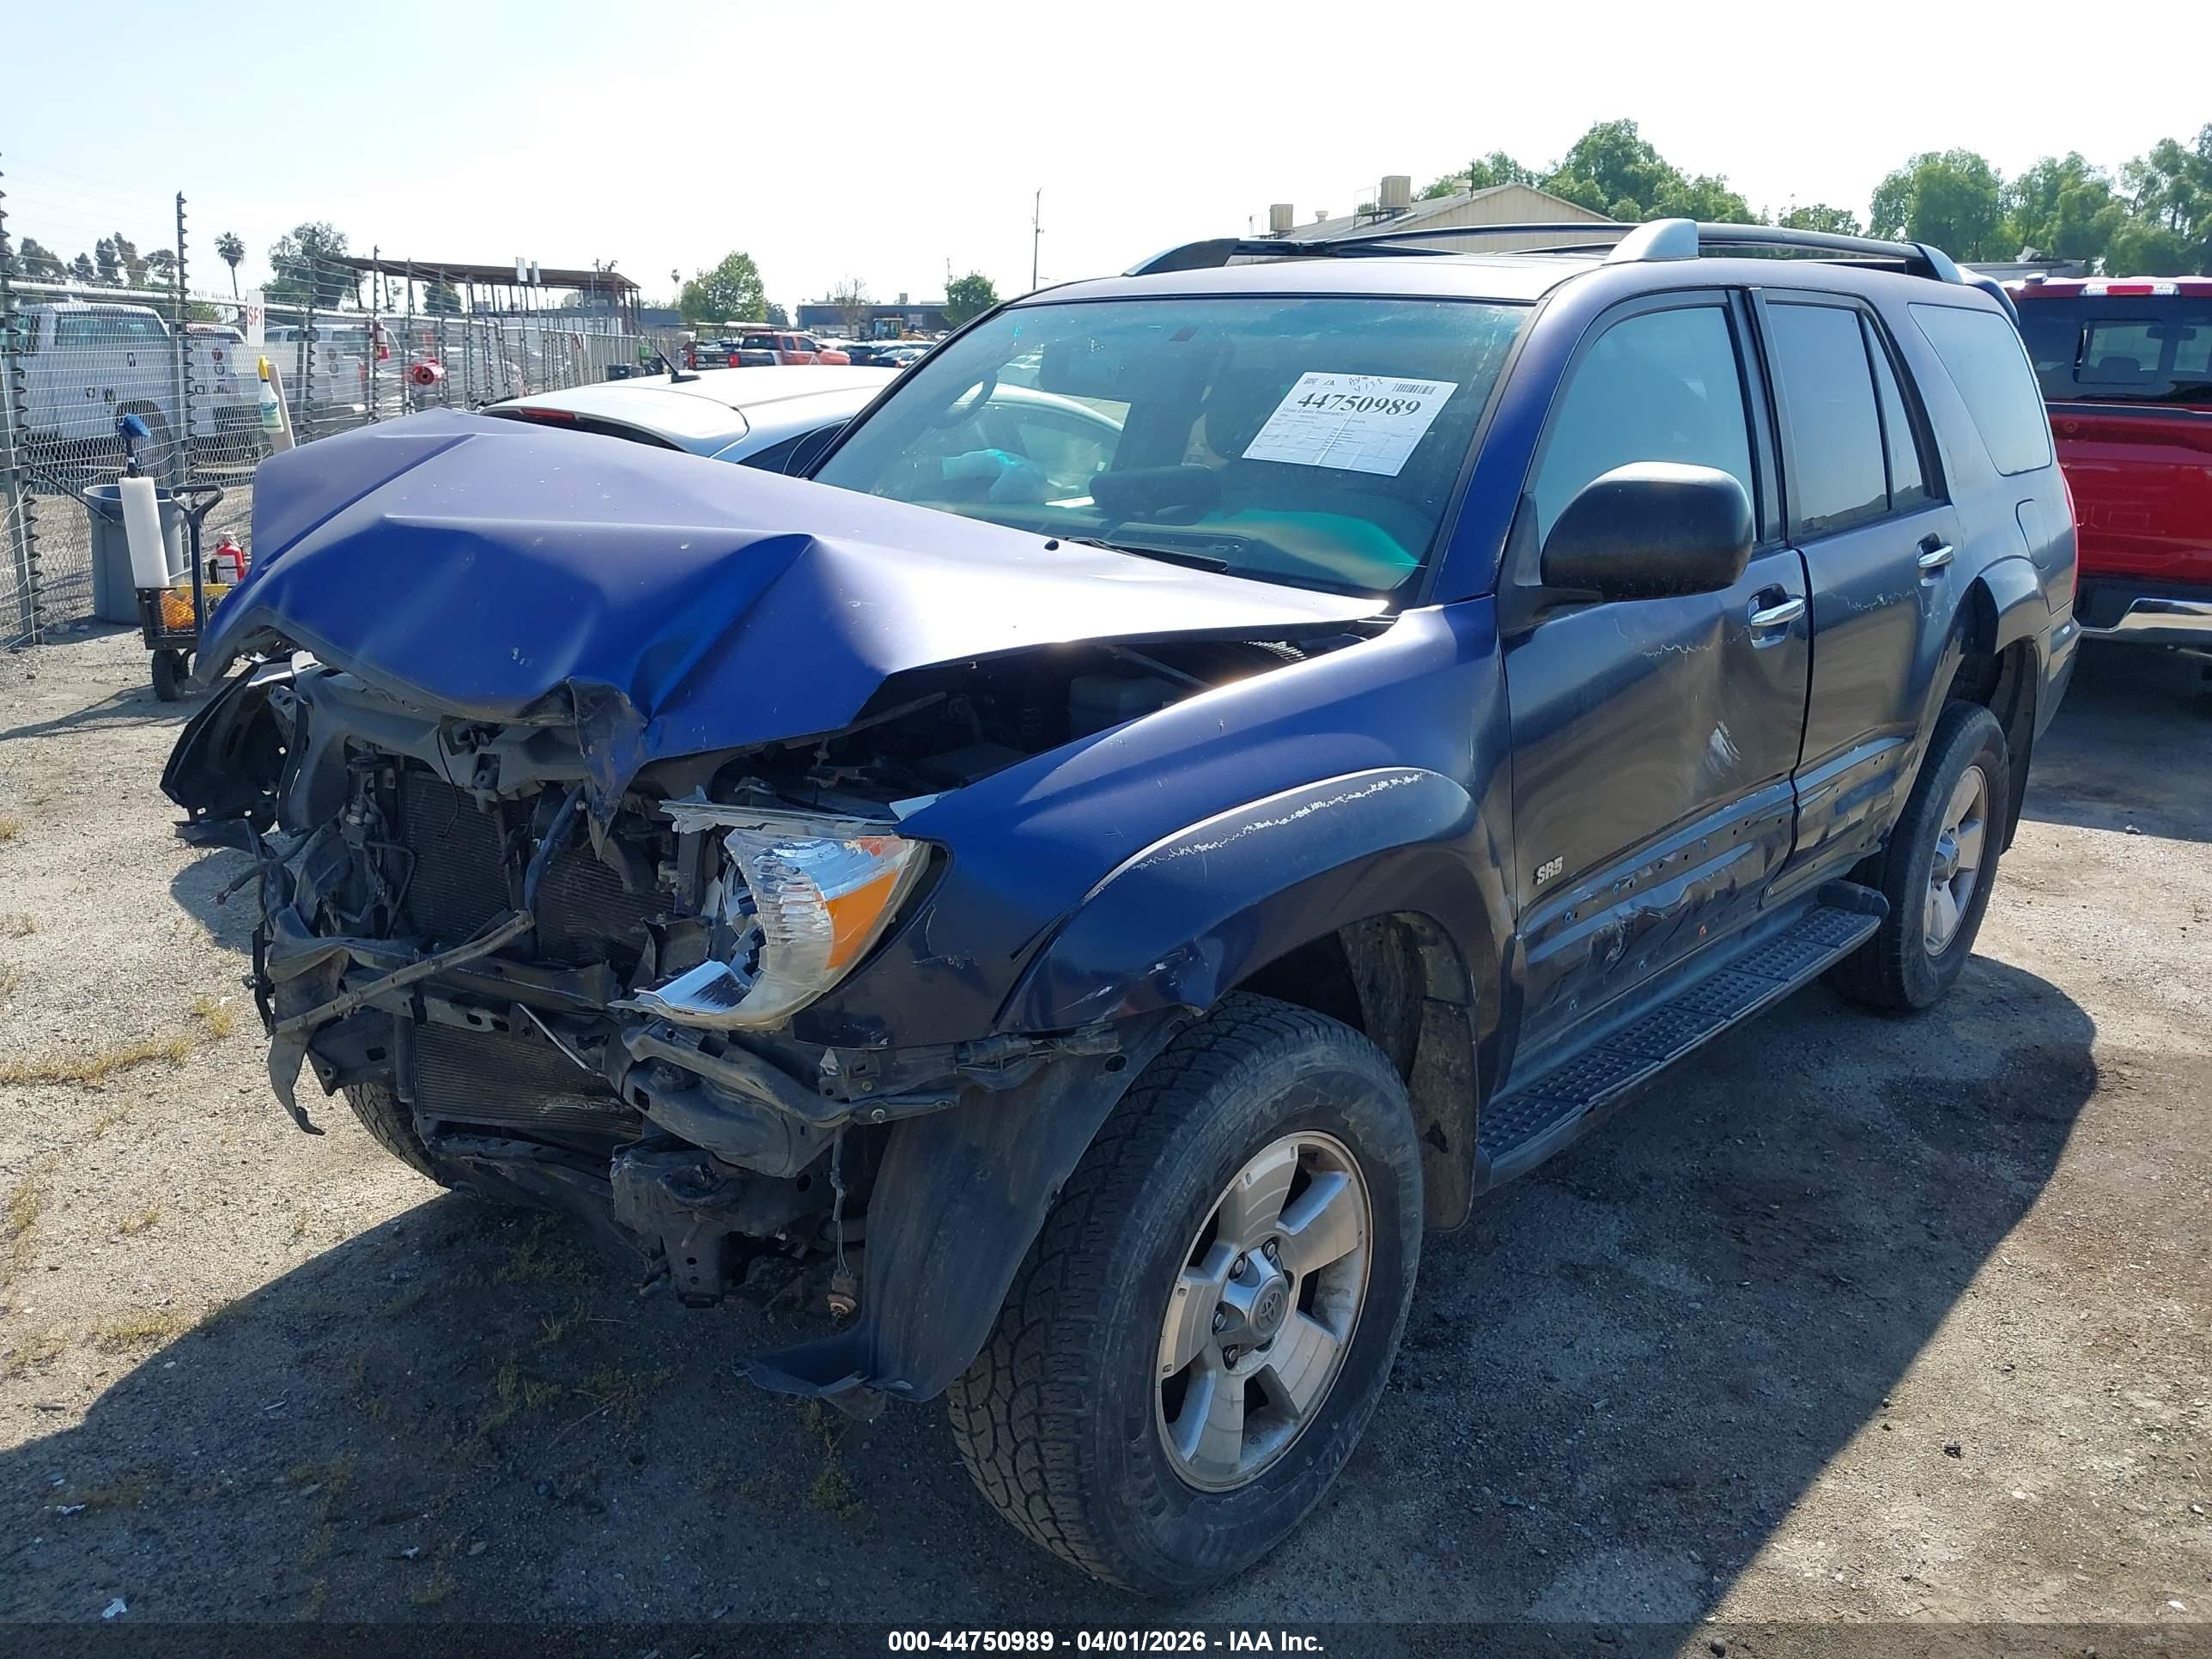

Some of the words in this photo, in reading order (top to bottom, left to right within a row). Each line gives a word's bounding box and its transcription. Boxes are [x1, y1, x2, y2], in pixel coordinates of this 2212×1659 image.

[248, 306, 263, 327] SF1
[1297, 392, 1421, 416] 44750989
[1535, 855, 1564, 886] SR5
